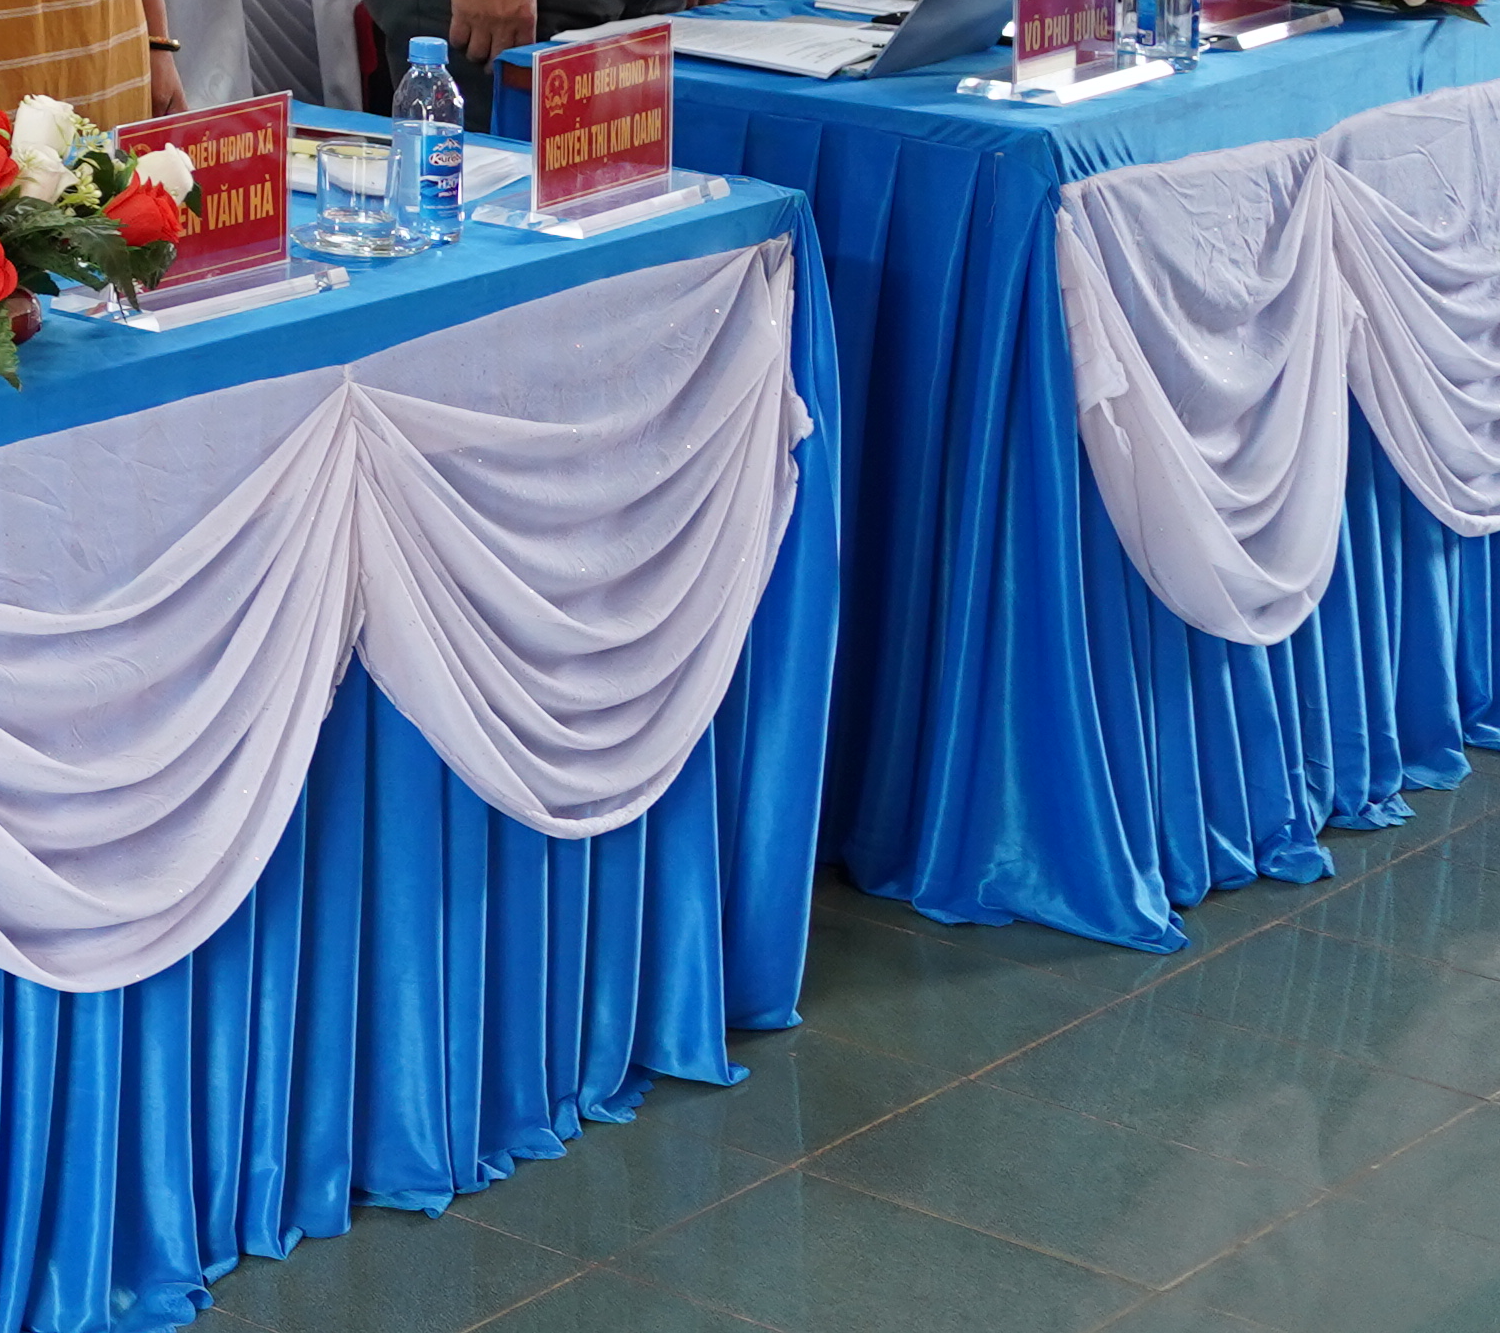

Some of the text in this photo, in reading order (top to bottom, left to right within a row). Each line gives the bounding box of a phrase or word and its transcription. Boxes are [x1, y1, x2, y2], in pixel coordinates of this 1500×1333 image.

[1024, 4, 1109, 52] VÕ PHÚ HÙNG
[575, 51, 661, 103] ĐẠI BIỂU HĐND XÃ
[188, 123, 274, 169] BIỂU HĐND XÃ
[545, 108, 662, 171] NGUYỄN THỊ KIM OANH
[206, 183, 244, 231] VĂN
[250, 174, 274, 221] HÀ
